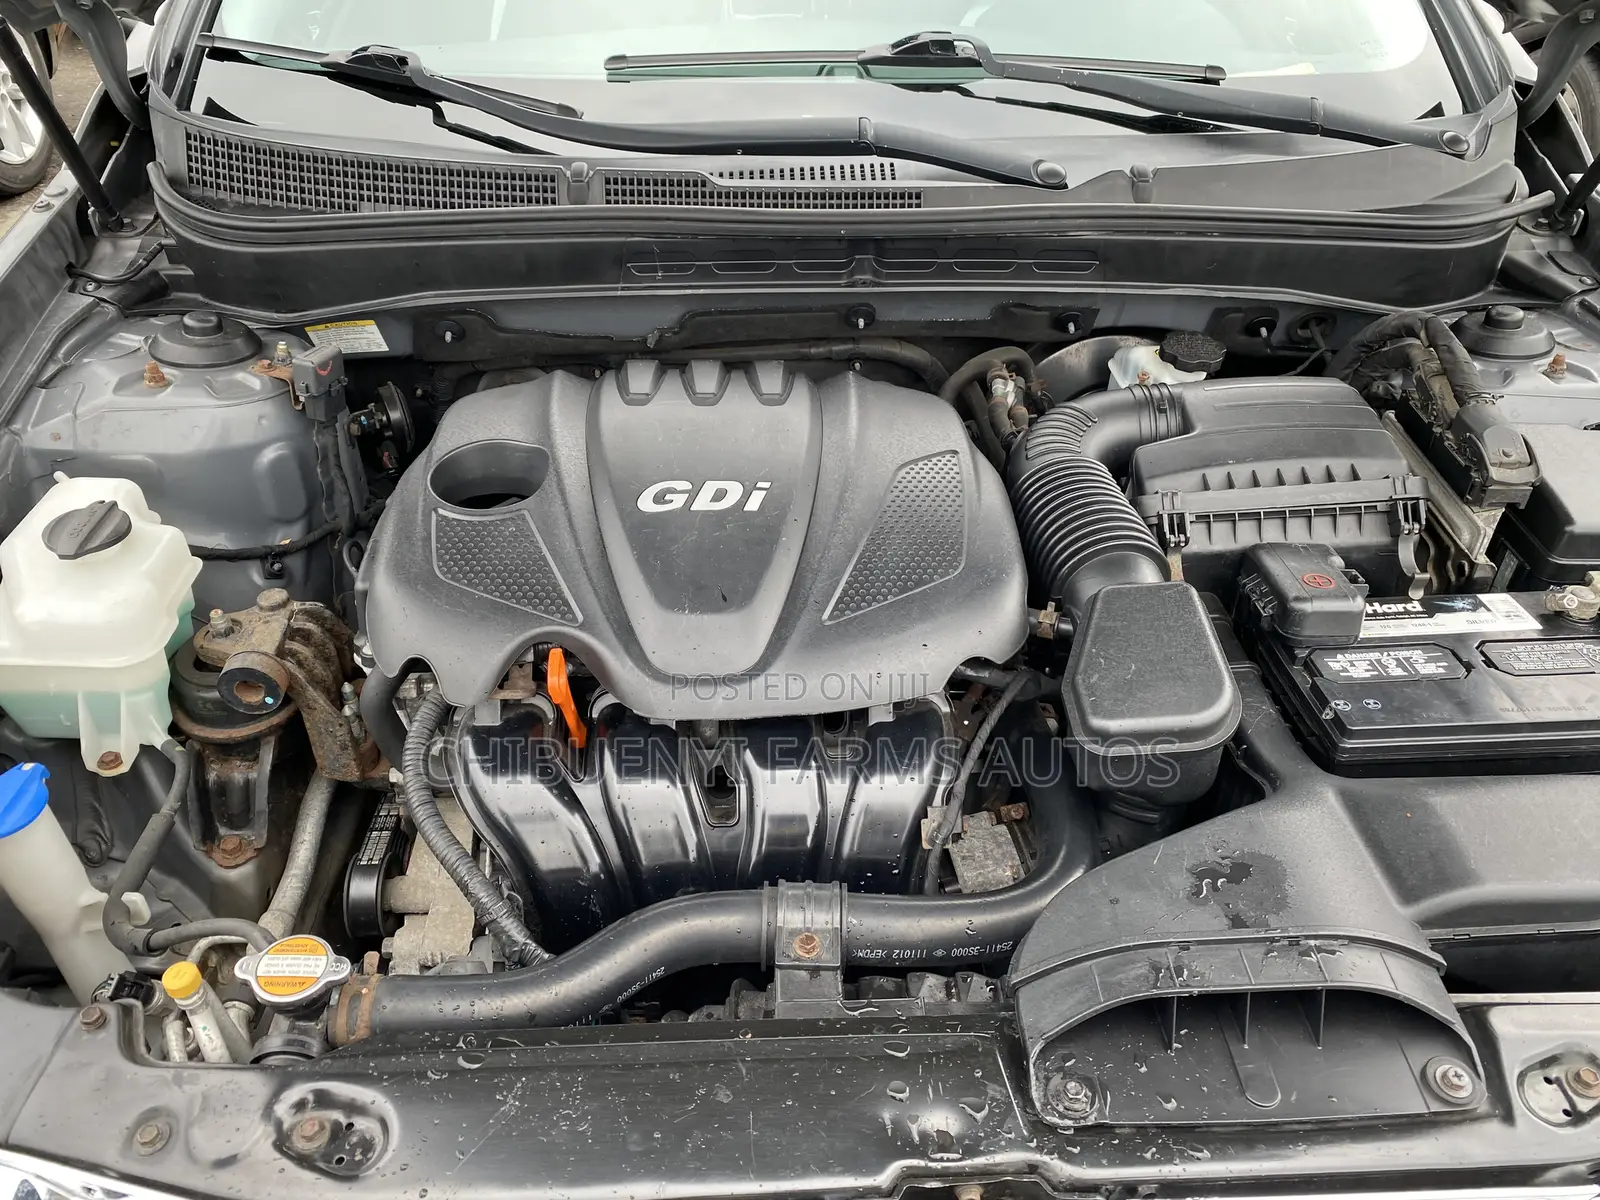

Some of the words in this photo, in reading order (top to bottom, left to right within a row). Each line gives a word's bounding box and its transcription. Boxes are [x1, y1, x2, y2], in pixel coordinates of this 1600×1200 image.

[636, 480, 772, 512] GDi
[1365, 600, 1424, 614] Hard
[1344, 652, 1381, 660] DANGER
[892, 949, 927, 958] 111012
[329, 962, 347, 971] HCC
